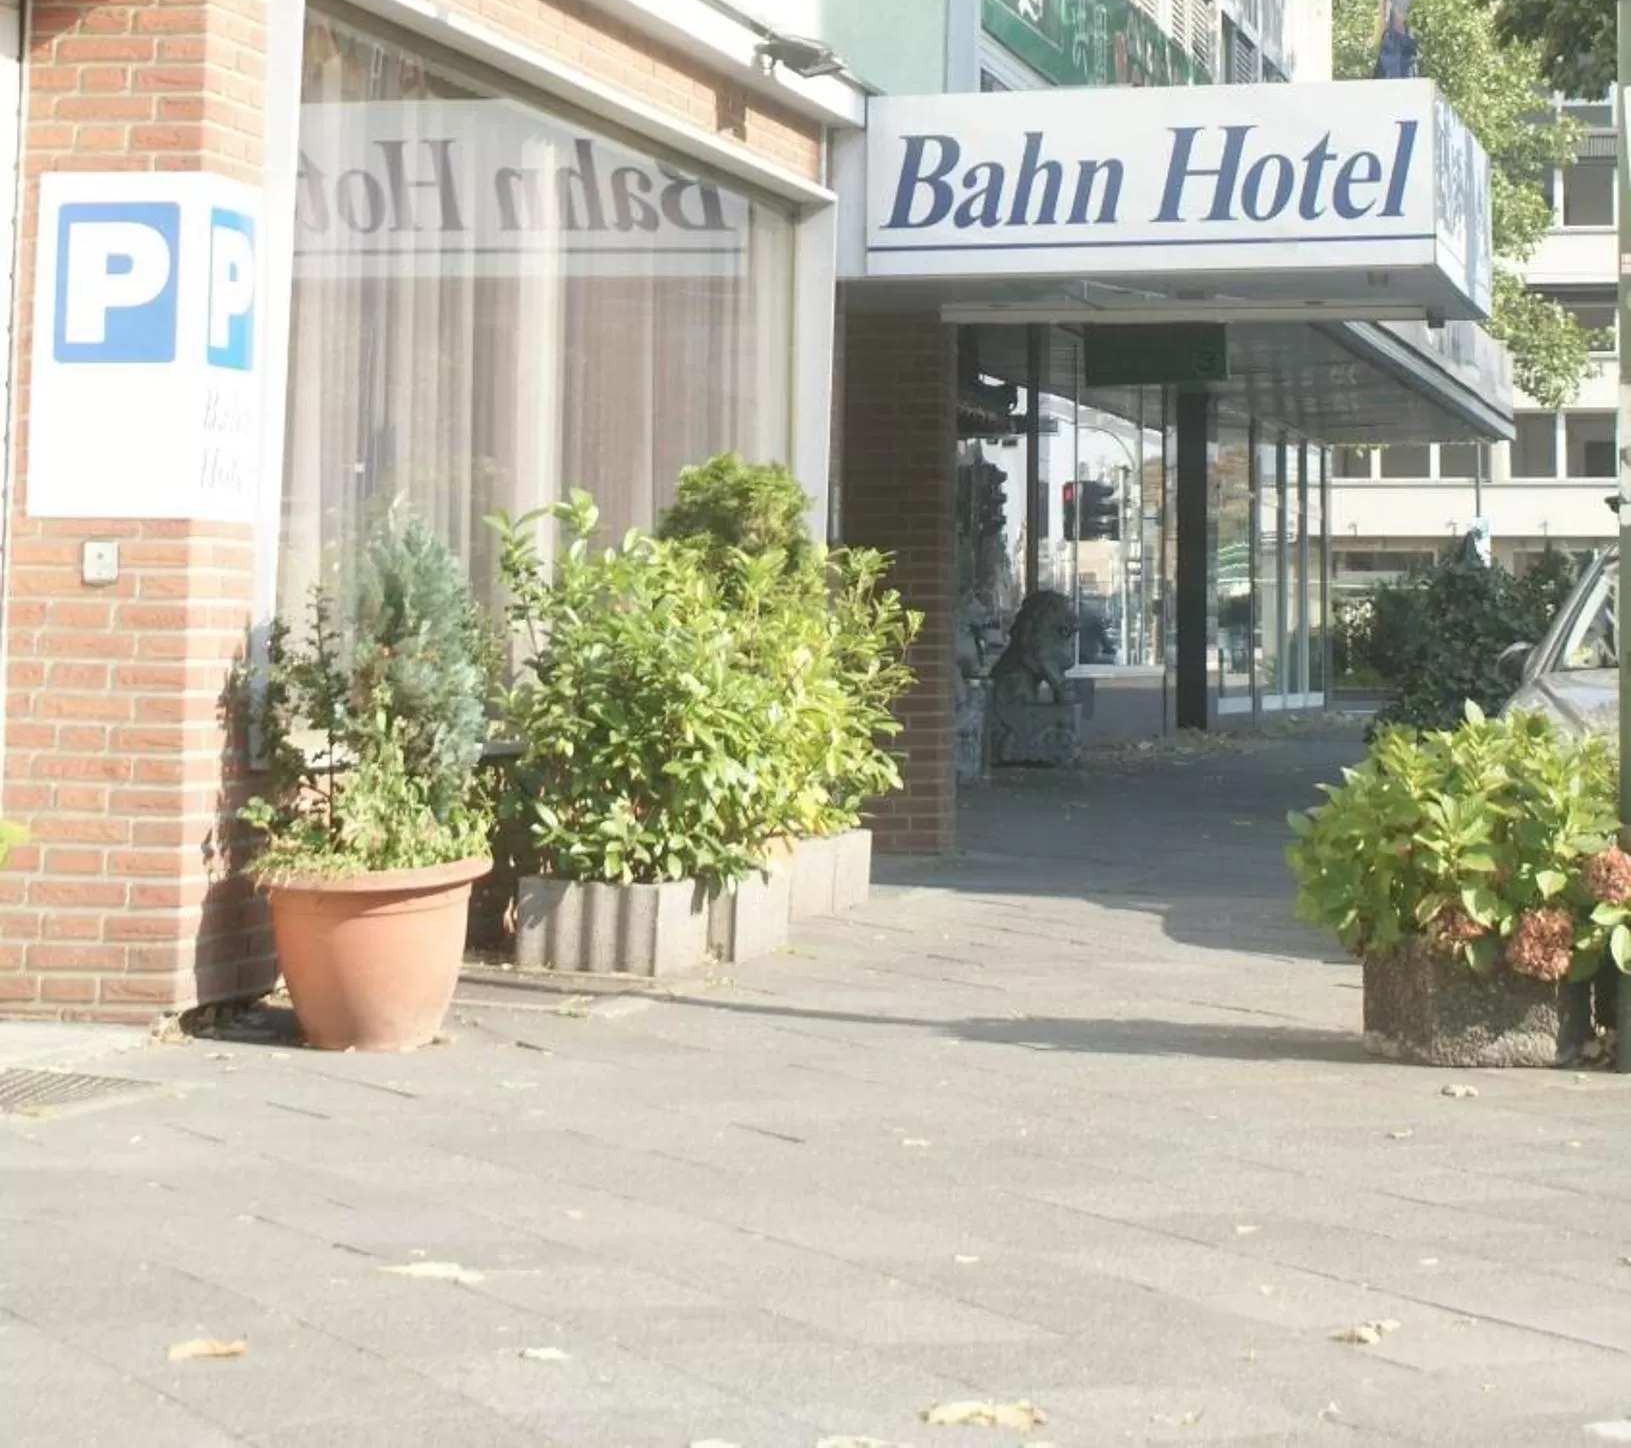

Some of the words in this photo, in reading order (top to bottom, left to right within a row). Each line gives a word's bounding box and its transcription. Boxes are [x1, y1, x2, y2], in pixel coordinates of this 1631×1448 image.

[879, 131, 1125, 230] Bahn
[1148, 120, 1419, 223] Hotel
[65, 220, 171, 344] P
[209, 224, 256, 350] P
